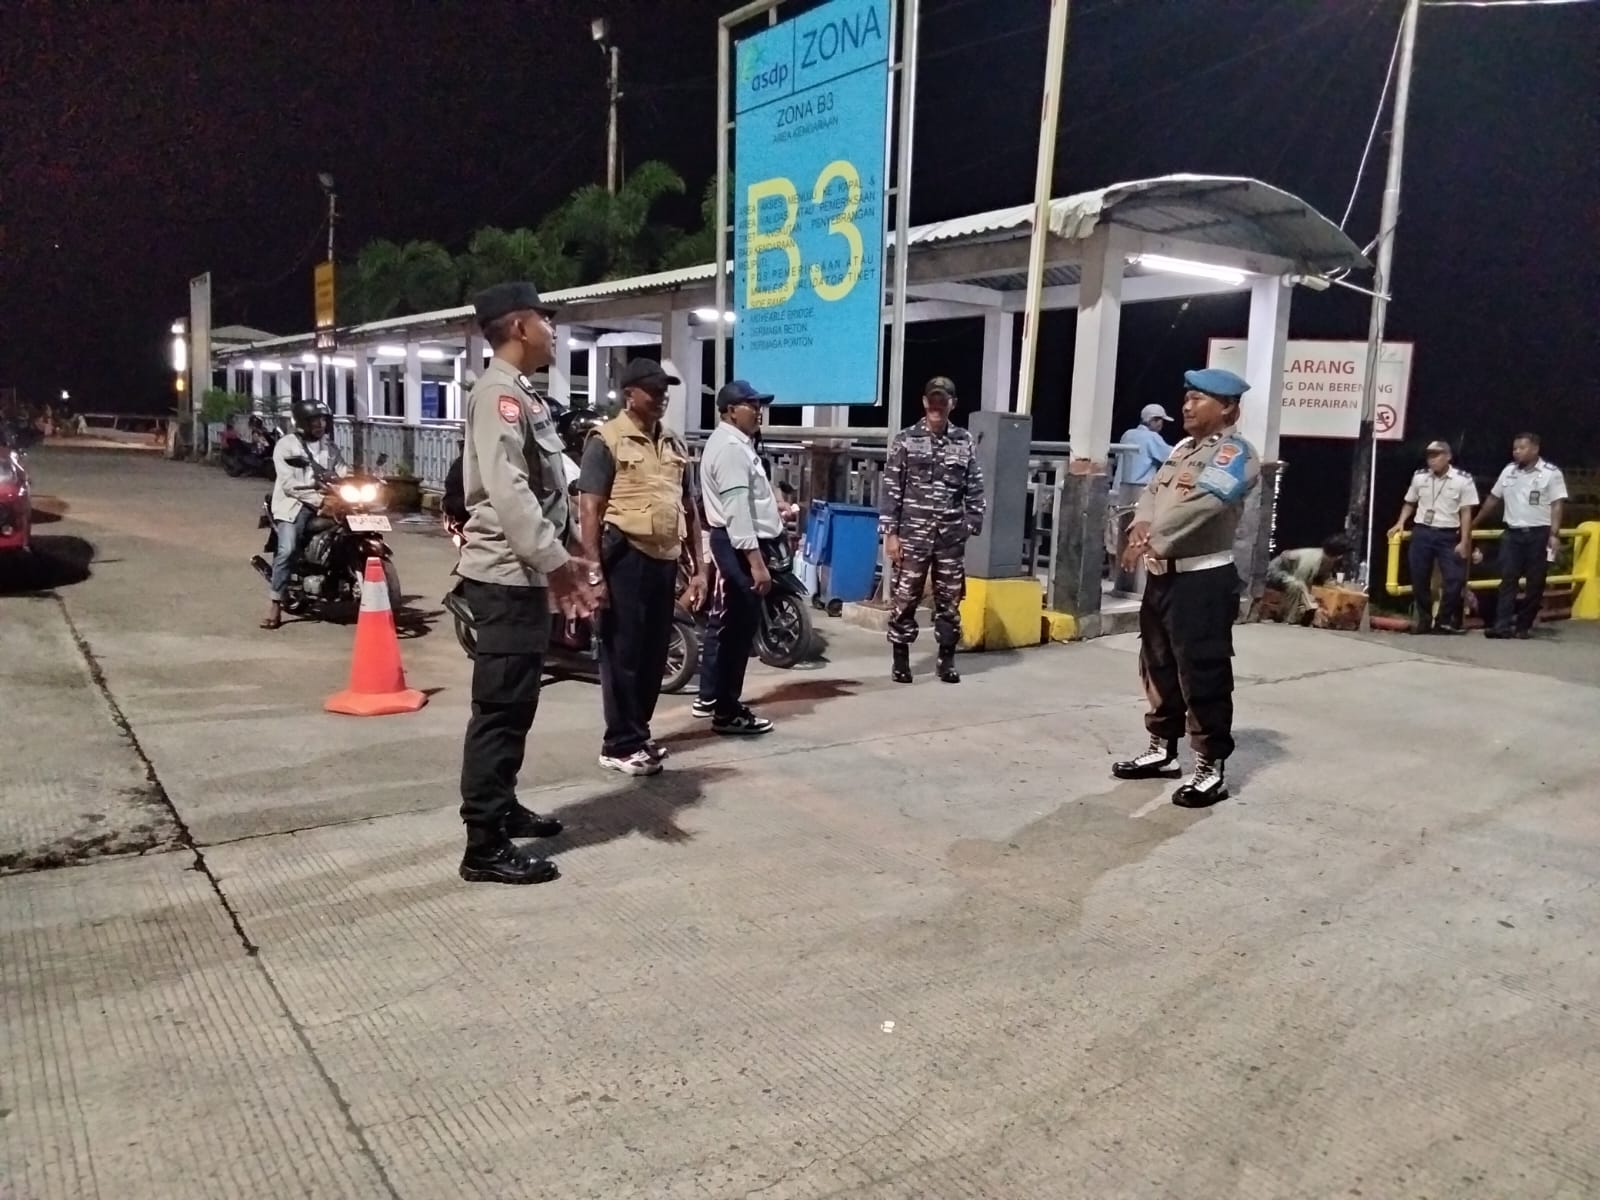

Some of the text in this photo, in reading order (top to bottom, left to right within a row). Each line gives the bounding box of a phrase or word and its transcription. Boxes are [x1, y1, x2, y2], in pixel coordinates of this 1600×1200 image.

[801, 4, 882, 70] ZONA
[751, 61, 789, 92] asdp
[776, 91, 834, 128] ZONA B3
[746, 159, 864, 309] B3
[1284, 359, 1355, 375] ARANG
[1298, 381, 1324, 392] DAN
[1300, 399, 1358, 409] PERAIRAN
